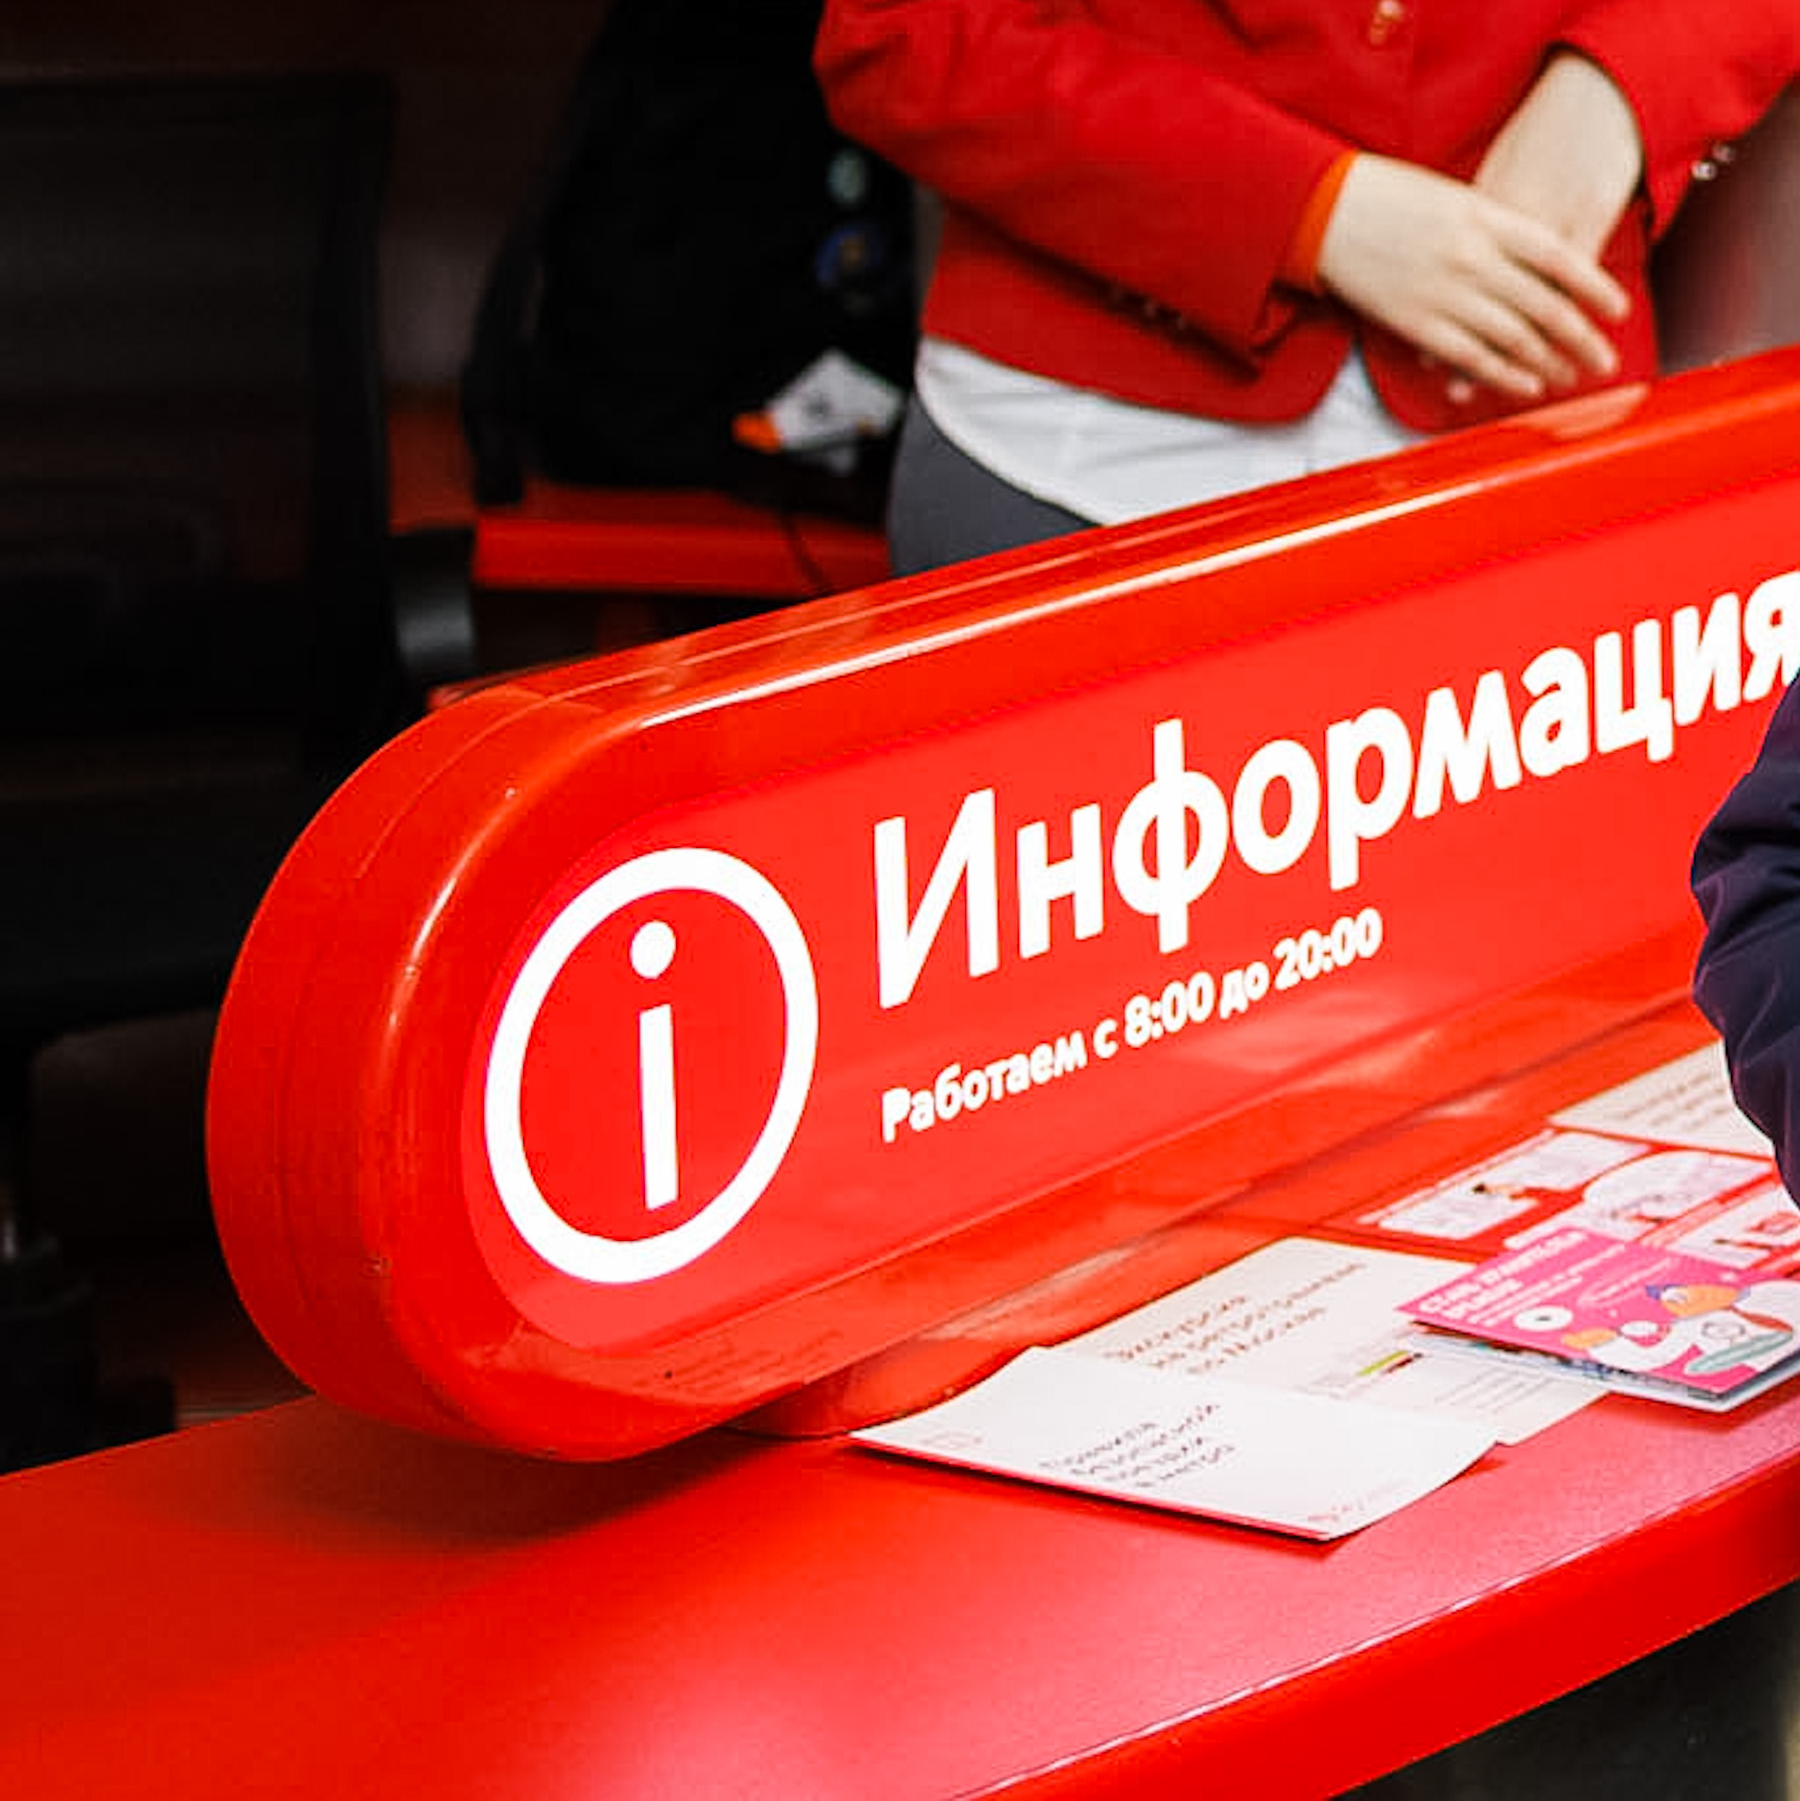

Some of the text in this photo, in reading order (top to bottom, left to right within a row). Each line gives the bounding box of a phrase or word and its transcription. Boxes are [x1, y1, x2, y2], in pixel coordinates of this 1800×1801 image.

[881, 907, 1384, 1143] Работаем с 8:00 до 20:00
